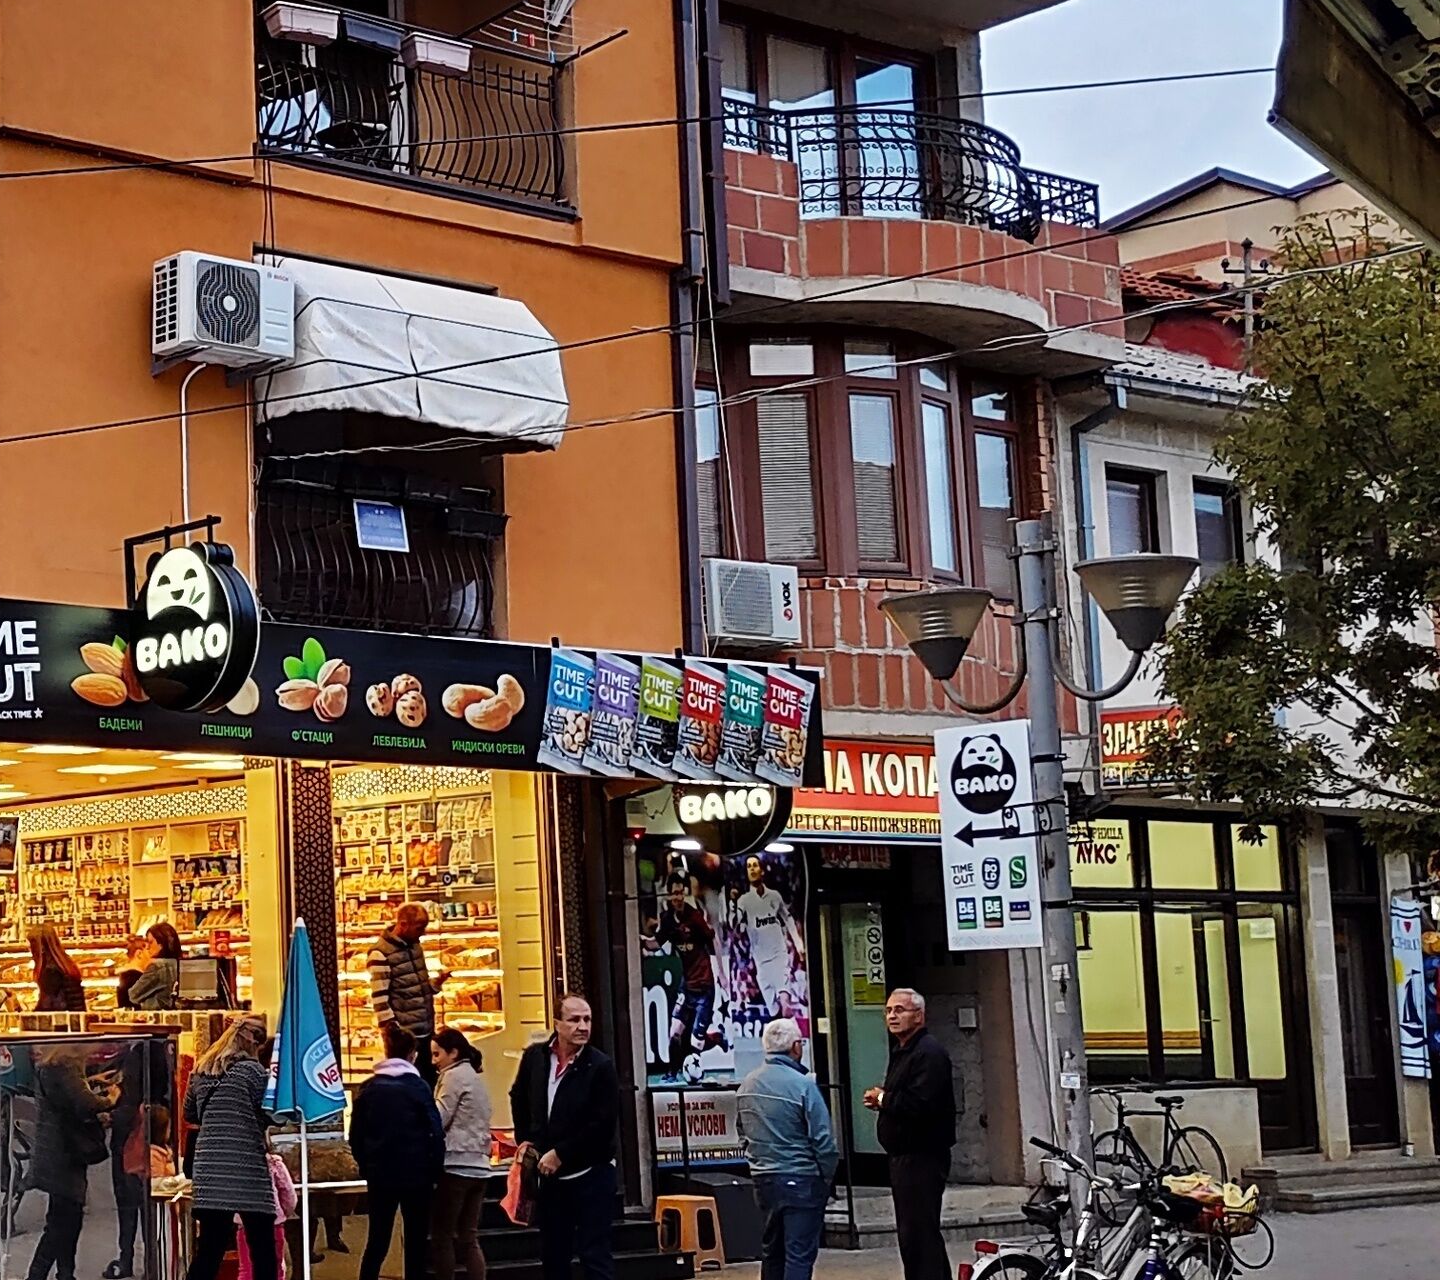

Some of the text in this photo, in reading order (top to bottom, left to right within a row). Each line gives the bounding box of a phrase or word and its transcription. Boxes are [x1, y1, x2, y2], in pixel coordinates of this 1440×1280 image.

[781, 581, 792, 608] VOX
[135, 622, 228, 673] BAKO
[554, 664, 586, 686] TIME
[598, 668, 631, 690] TIME
[644, 673, 674, 694] TIME
[553, 680, 585, 702] OUT
[598, 684, 630, 707] OUT
[688, 677, 718, 699] TIME
[730, 679, 759, 700] TIME
[770, 683, 799, 704] TIME
[643, 688, 673, 710] OUT
[687, 692, 716, 714] OUT
[729, 695, 758, 716] OUT
[769, 699, 797, 719] OUT
[13, 710, 33, 719] TIME
[99, 717, 143, 731] БАДЕМИ
[200, 724, 253, 739] ЛЕШНИЦИ
[372, 735, 427, 749] ЛЕБЛЕБИЈА
[452, 740, 526, 755] ИНДИСКИ ОРЕВИ
[954, 774, 1014, 795] BAKO
[679, 788, 772, 824] BAKO
[951, 863, 973, 874] TIME
[1010, 858, 1025, 882] S
[953, 873, 975, 886] OUT
[958, 901, 975, 914] BE
[984, 900, 1002, 912] BE
[657, 1114, 727, 1138] НЕМ УСЛОВИ
